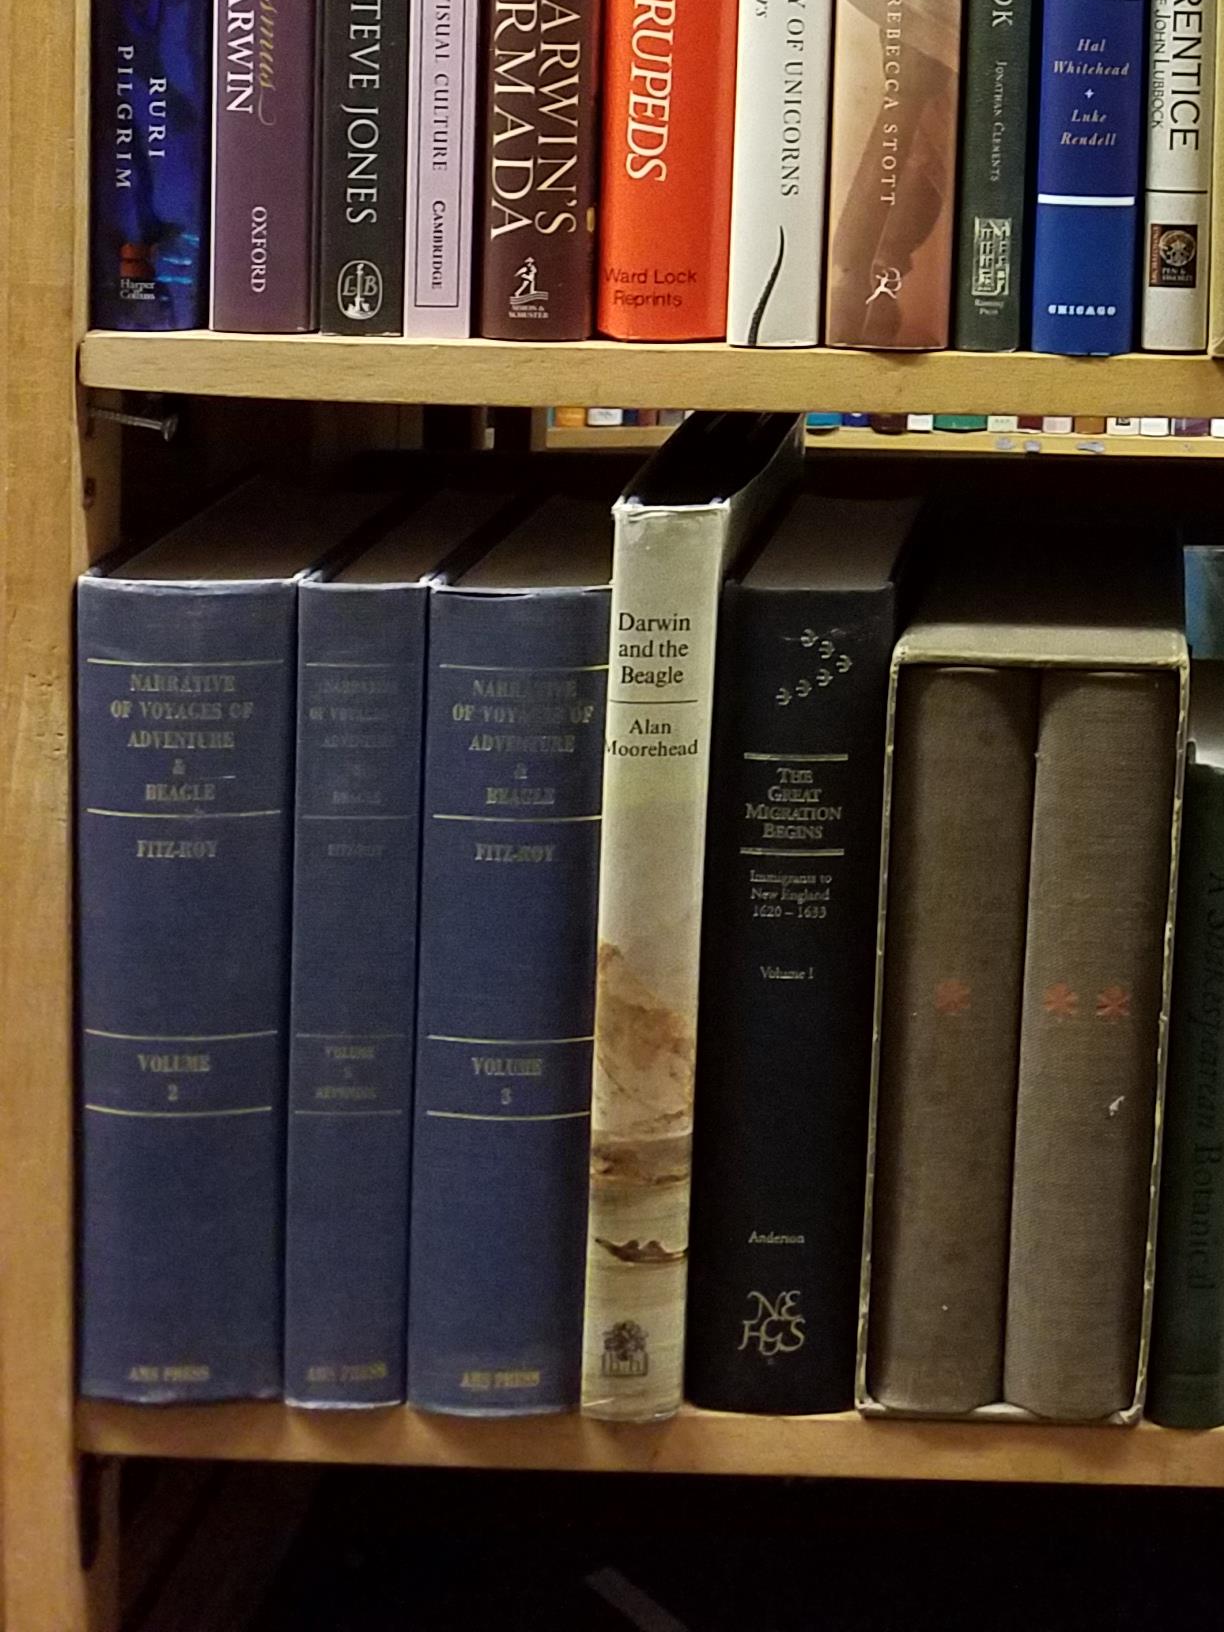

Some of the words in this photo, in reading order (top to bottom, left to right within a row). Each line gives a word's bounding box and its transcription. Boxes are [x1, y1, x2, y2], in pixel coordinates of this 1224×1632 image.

[785, 18, 806, 52] OF
[116, 45, 134, 188] PILGRIM
[148, 77, 167, 157] RURI
[431, 73, 450, 172] CULTURE
[780, 61, 803, 197] UNICORNS
[340, 104, 380, 225] JONES
[250, 206, 267, 293] OXFORD
[430, 200, 446, 290] CAMBRIDGE
[618, 612, 691, 633] Darwin
[618, 640, 654, 658] and
[658, 640, 689, 658] the
[620, 666, 684, 688] Beagle
[629, 719, 672, 736] Alan
[777, 768, 814, 785] THE
[767, 786, 822, 803] GREAT
[745, 803, 842, 822] MIGRATION
[763, 822, 823, 840] BEGINS
